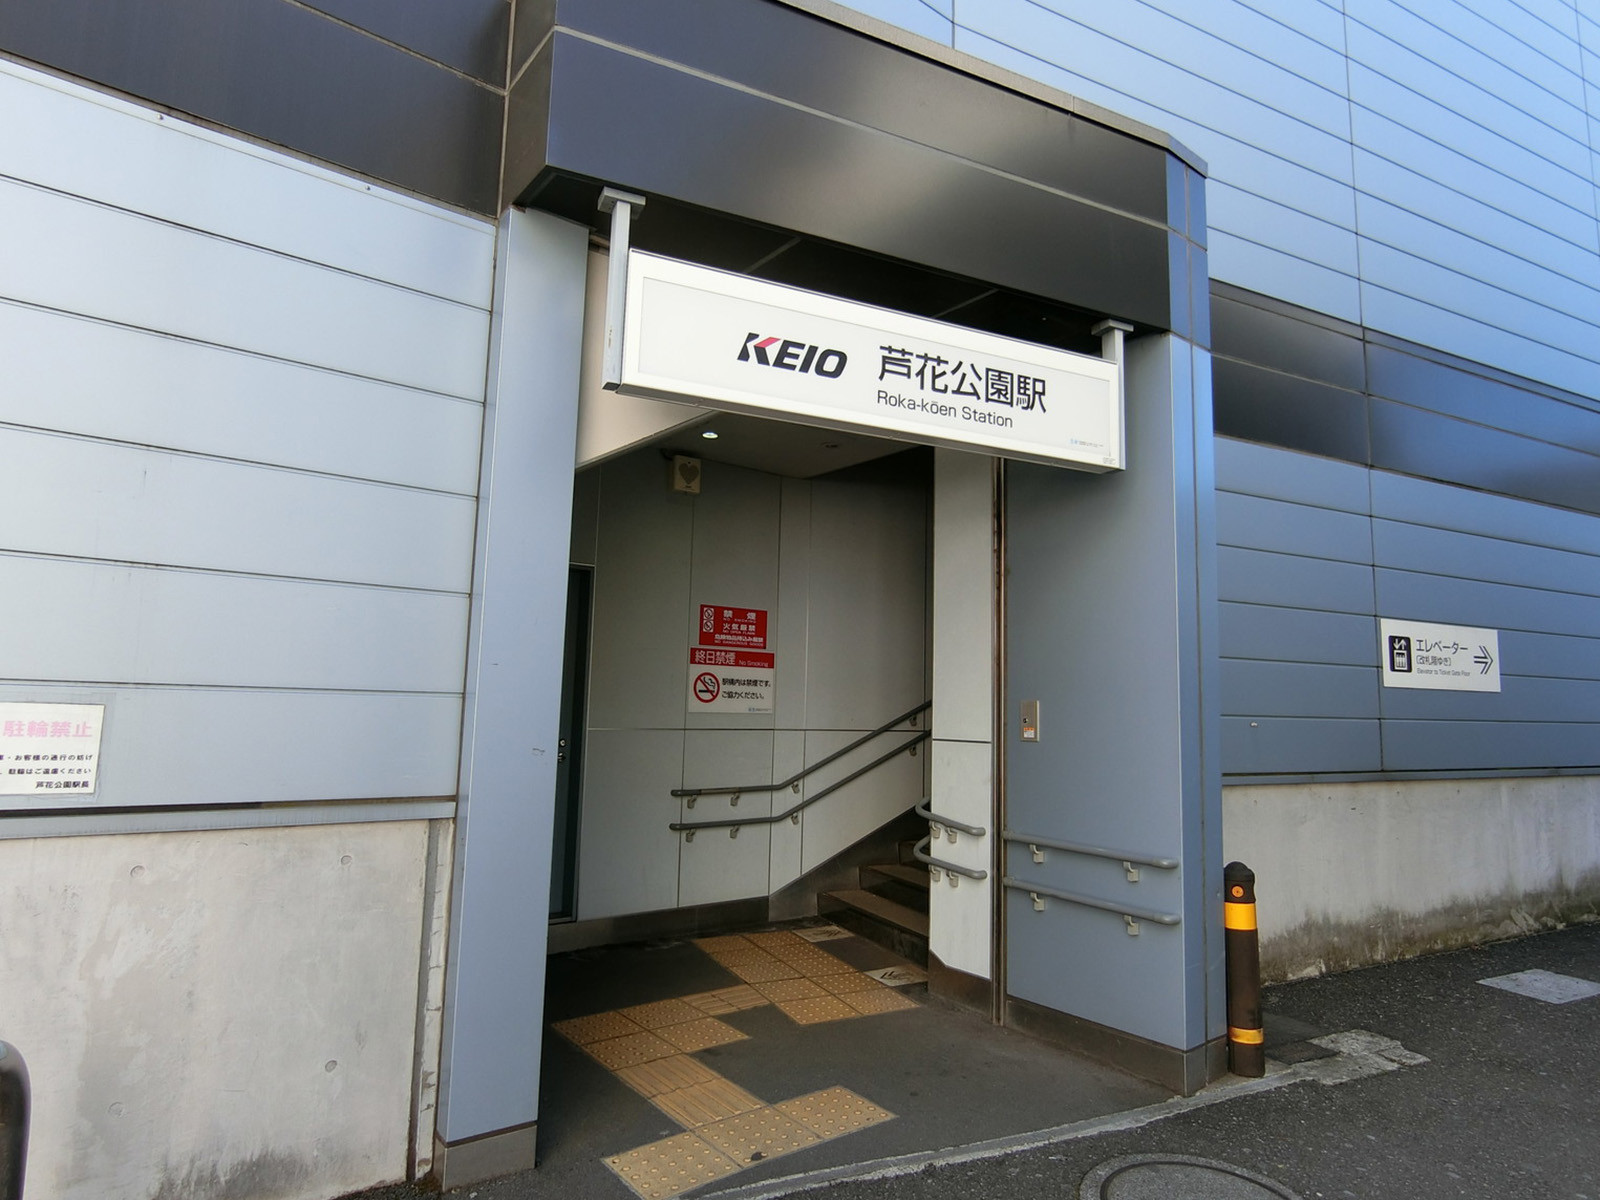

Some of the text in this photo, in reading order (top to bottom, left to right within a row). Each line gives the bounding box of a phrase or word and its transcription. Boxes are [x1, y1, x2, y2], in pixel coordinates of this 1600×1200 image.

[737, 332, 848, 379] KEIO
[878, 345, 1047, 413] 芦花公園駅
[877, 390, 1013, 428] Roka-kōen Station
[695, 650, 736, 665] 終日禁煙
[1416, 639, 1469, 655] エレベーター
[3, 720, 93, 738] 駐輪禁止
